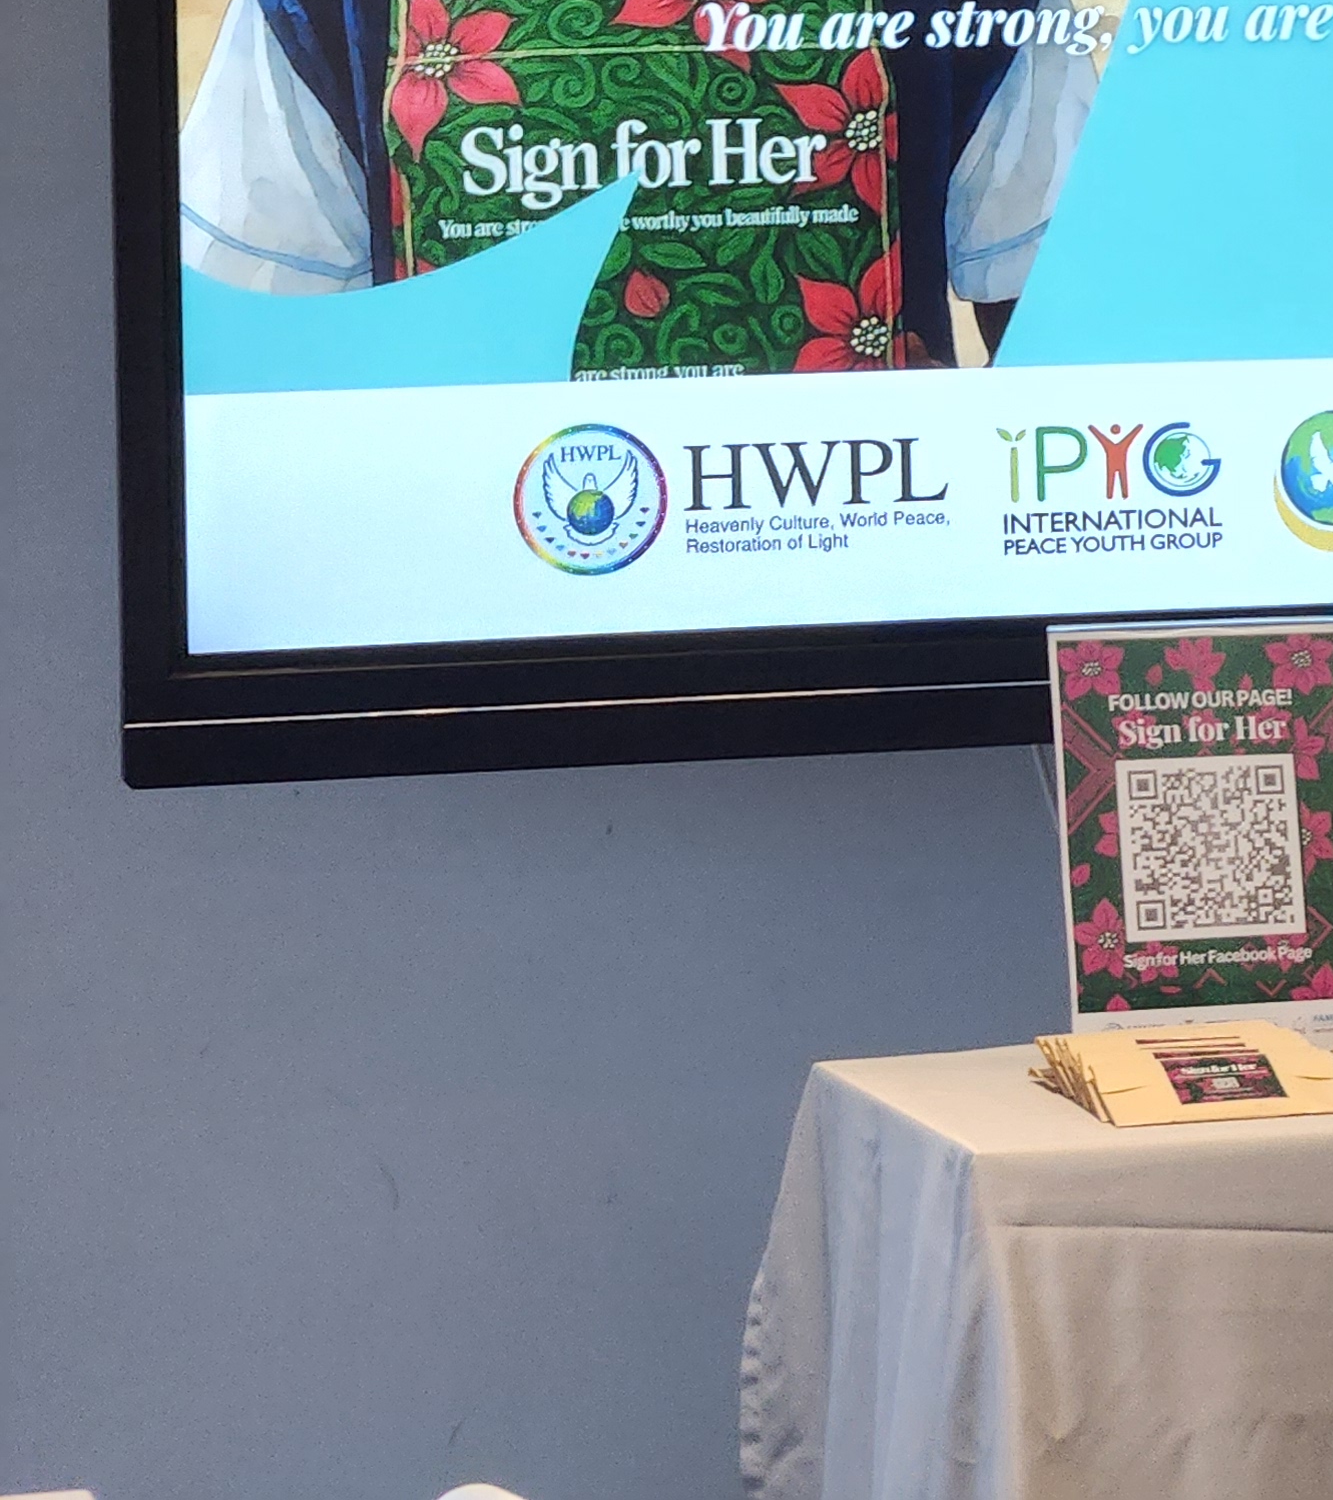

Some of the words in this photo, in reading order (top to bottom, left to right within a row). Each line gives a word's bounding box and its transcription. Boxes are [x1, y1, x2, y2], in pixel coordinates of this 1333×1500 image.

[699, 0, 805, 54] You
[817, 8, 911, 52] are
[924, 1, 1113, 56] strong,
[1126, 5, 1231, 55] you
[1240, 1, 1332, 43] are
[460, 123, 602, 210] Sign
[612, 119, 701, 190] for
[707, 117, 827, 188] Her
[438, 219, 472, 240] You
[474, 222, 504, 238] are
[631, 211, 690, 233] worthy
[690, 214, 723, 232] you
[725, 206, 810, 229] beautifully
[811, 204, 859, 224] made
[560, 444, 621, 462] HWPL
[683, 437, 949, 511] HWPL
[685, 518, 764, 536] Heavenly
[769, 515, 835, 532] Culture,
[839, 512, 889, 528] World
[893, 509, 951, 528] Peace,
[1003, 506, 1223, 535] INTERNATIONAL
[685, 536, 782, 554] Restoration
[787, 534, 804, 550] of
[808, 533, 849, 552] Light
[1004, 537, 1067, 556] PEACE
[1071, 534, 1145, 553] YOUTH
[1150, 532, 1223, 551] GROUP
[1107, 692, 1191, 712] FOLLOW
[1191, 690, 1236, 708] OUR
[1236, 688, 1293, 707] PAGE!
[1117, 718, 1182, 750] Sign
[1188, 715, 1230, 742] for
[1234, 715, 1287, 741] Her
[1123, 953, 1157, 972] Sign
[1156, 951, 1178, 967] for
[1179, 950, 1208, 965] Her
[1208, 946, 1278, 964] Facebook
[1278, 945, 1313, 963] Page
